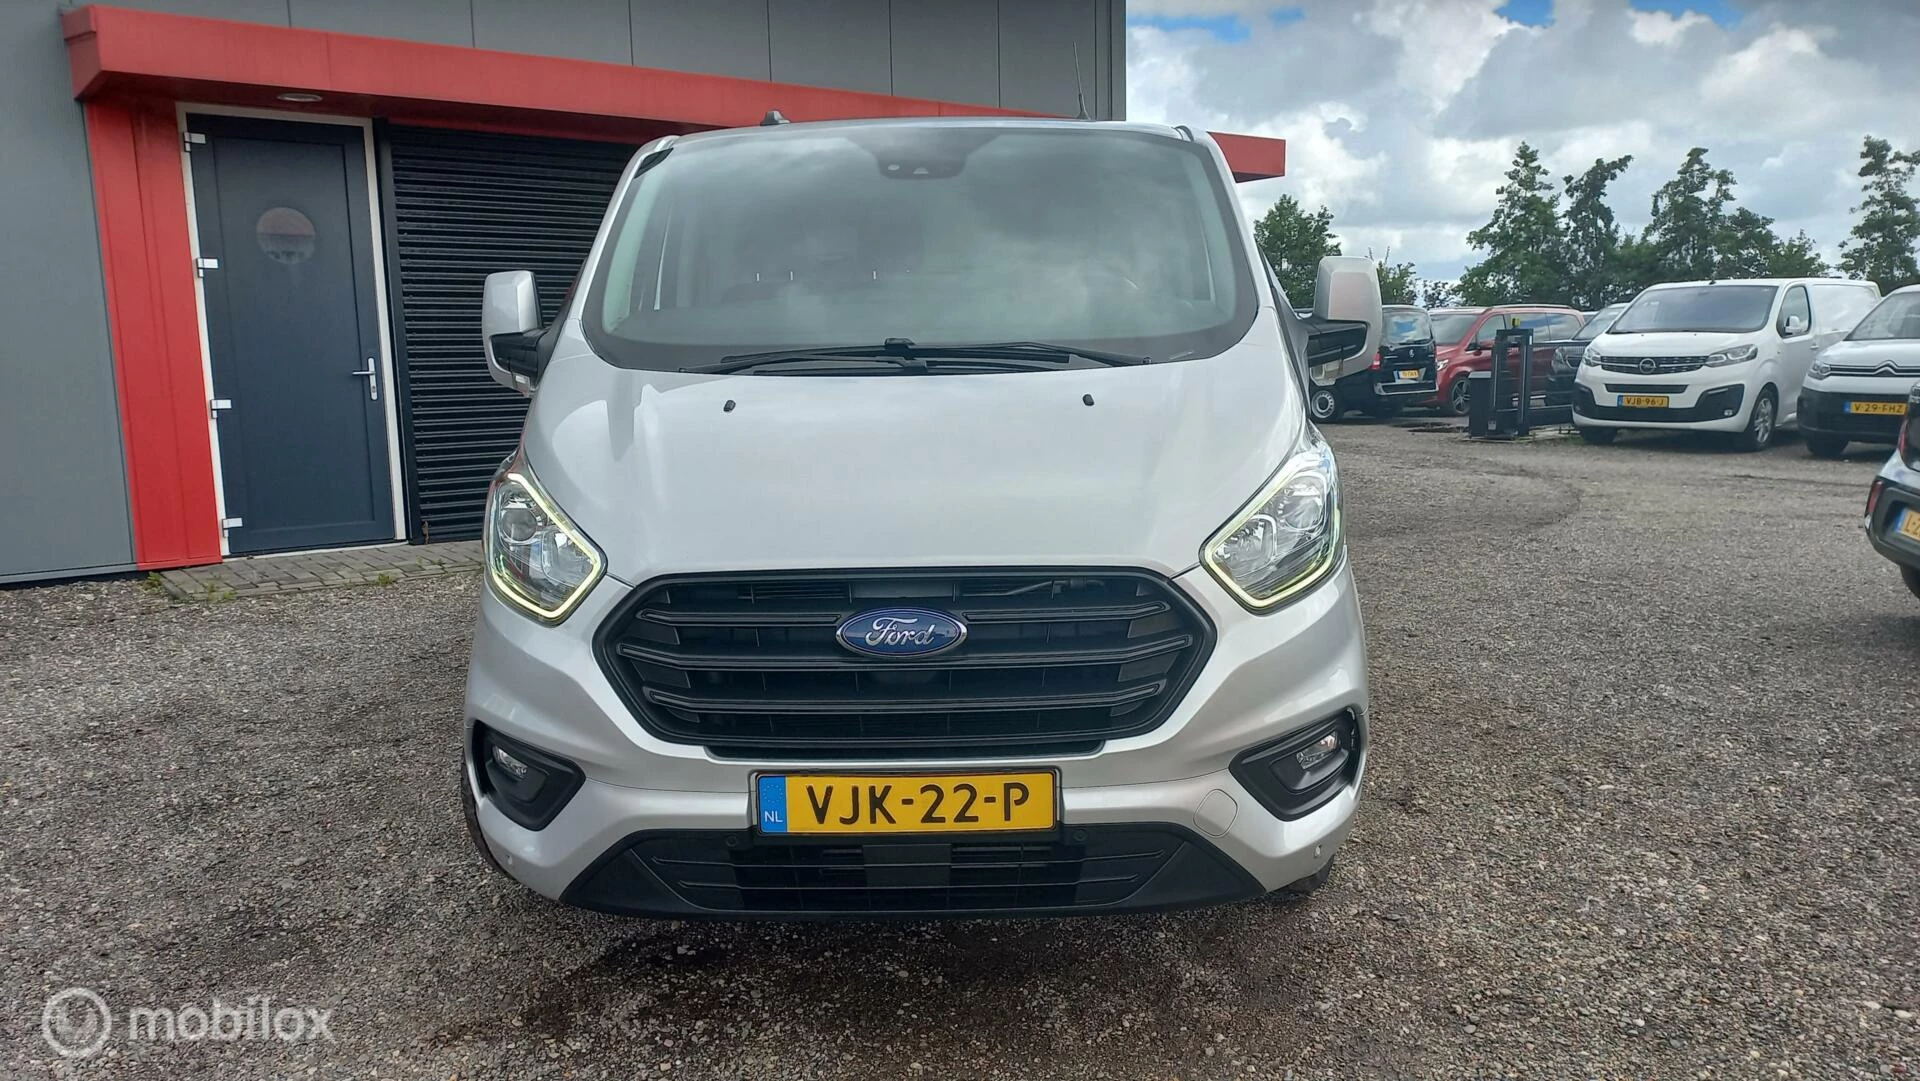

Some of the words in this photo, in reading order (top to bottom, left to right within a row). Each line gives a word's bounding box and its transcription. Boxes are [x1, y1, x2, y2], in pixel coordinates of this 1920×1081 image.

[1625, 397, 1664, 406] VJB-96-J
[1854, 403, 1904, 413] V-29-FHZ
[865, 617, 936, 646] Ford
[806, 782, 1030, 825] VJK-22-P
[764, 811, 783, 823] NL
